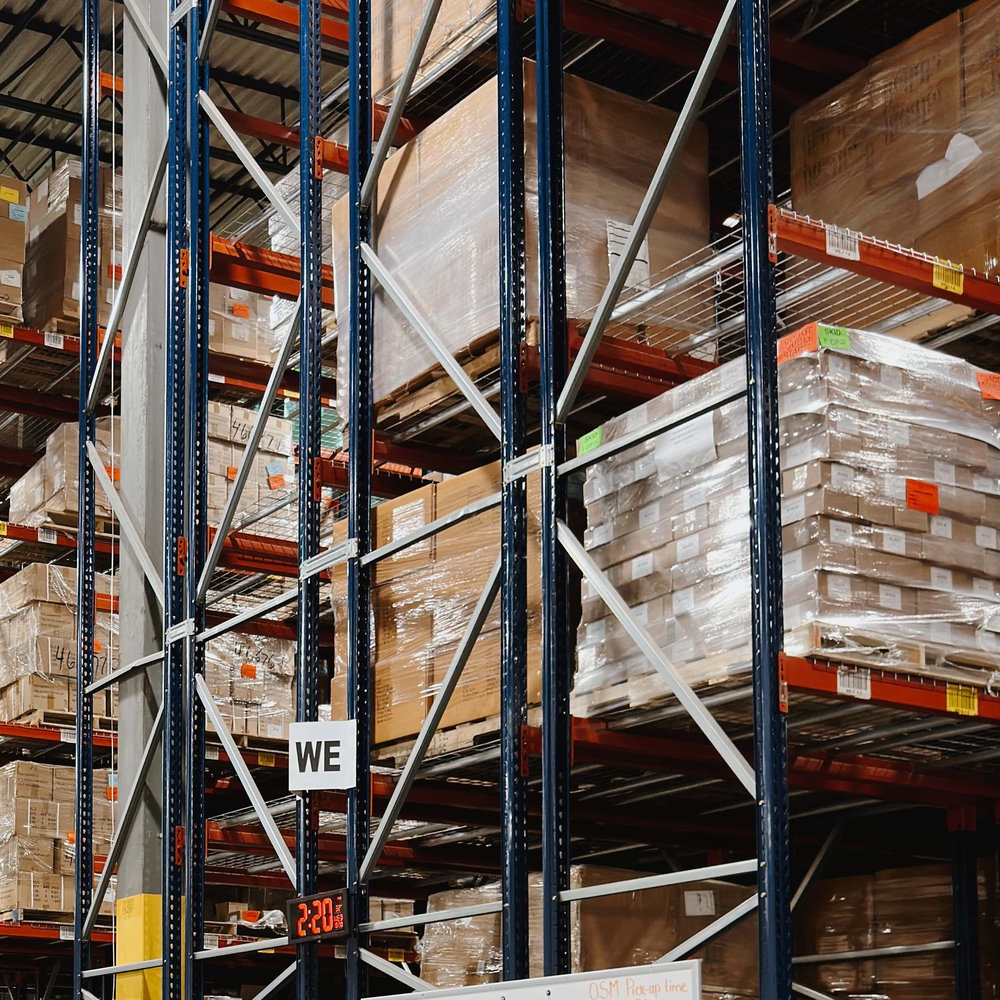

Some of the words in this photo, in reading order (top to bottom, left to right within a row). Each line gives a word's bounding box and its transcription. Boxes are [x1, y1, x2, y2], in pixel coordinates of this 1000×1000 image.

[824, 328, 841, 336] SKID
[296, 740, 340, 772] WE
[297, 898, 334, 937] 2:20
[589, 979, 619, 1000] OSM
[626, 978, 660, 998] Pick-up
[664, 979, 688, 992] time
